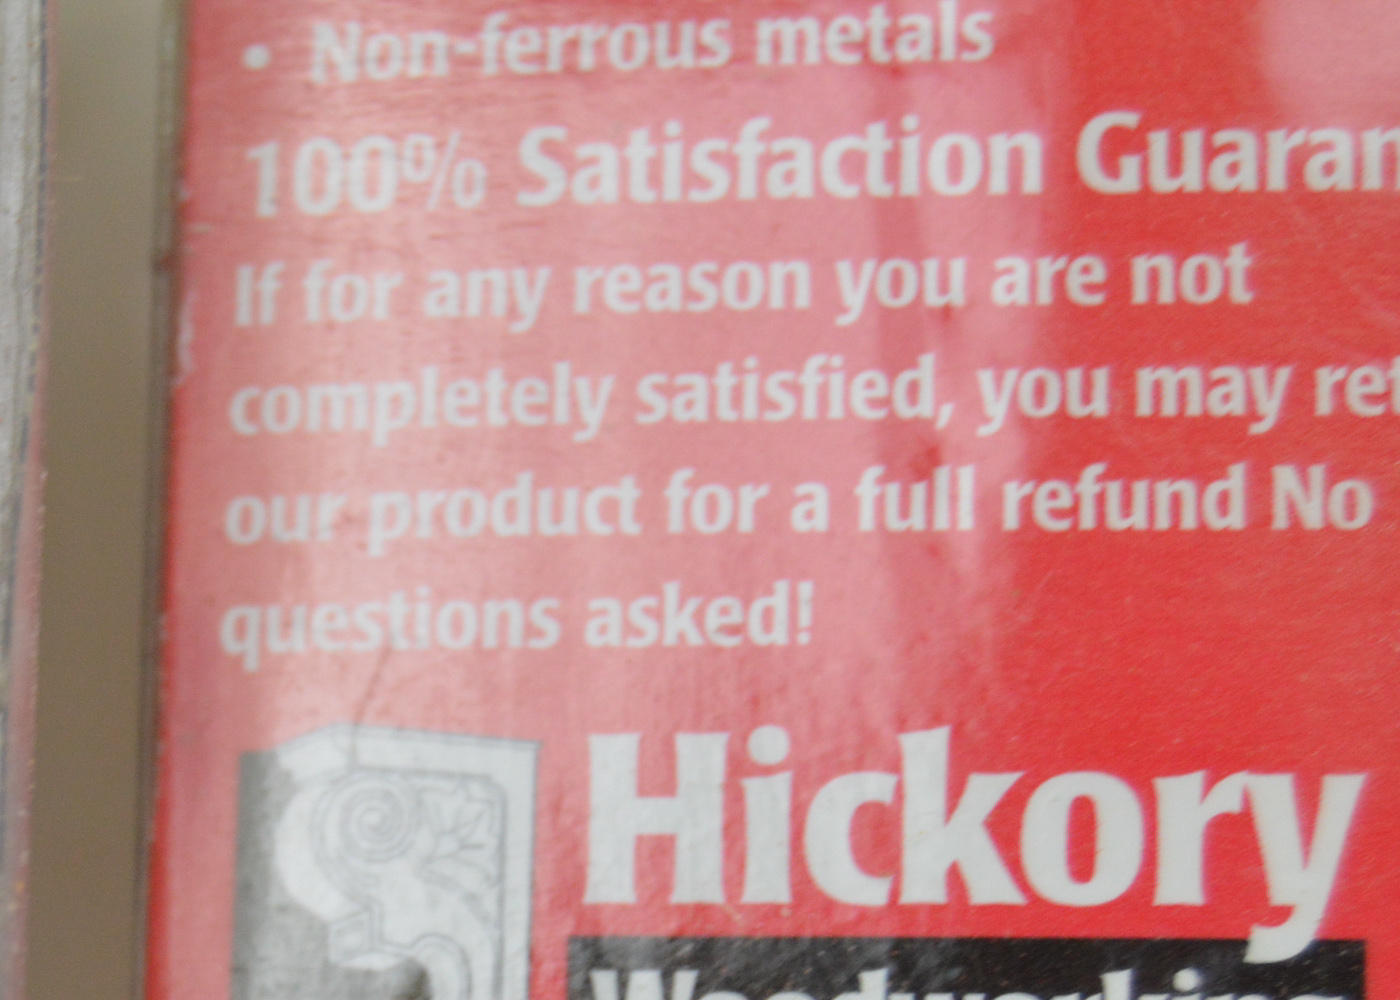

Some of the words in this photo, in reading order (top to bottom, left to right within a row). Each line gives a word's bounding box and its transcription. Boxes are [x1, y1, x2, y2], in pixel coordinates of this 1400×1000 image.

[310, 13, 730, 84] Non-ferrous
[755, 0, 995, 66] metals
[246, 130, 487, 218] 100%
[517, 115, 1044, 207] Satisfaction
[234, 260, 287, 328] If
[303, 258, 402, 324] for
[423, 265, 551, 334] any
[574, 258, 812, 314] reason
[834, 257, 968, 326] you
[991, 253, 1107, 306] are
[1130, 241, 1255, 306] not
[228, 361, 615, 448] completely
[635, 353, 954, 429] satisfied,
[976, 365, 1110, 436] you
[1135, 364, 1293, 434] may
[224, 491, 349, 544] our
[367, 470, 641, 558] product
[663, 467, 770, 534] for
[790, 481, 830, 533] a
[855, 463, 975, 531] full
[1002, 461, 1247, 531] refund
[1270, 463, 1375, 531] No
[218, 585, 561, 672] questions
[585, 580, 814, 648] asked!
[583, 725, 1372, 964] Hickory
